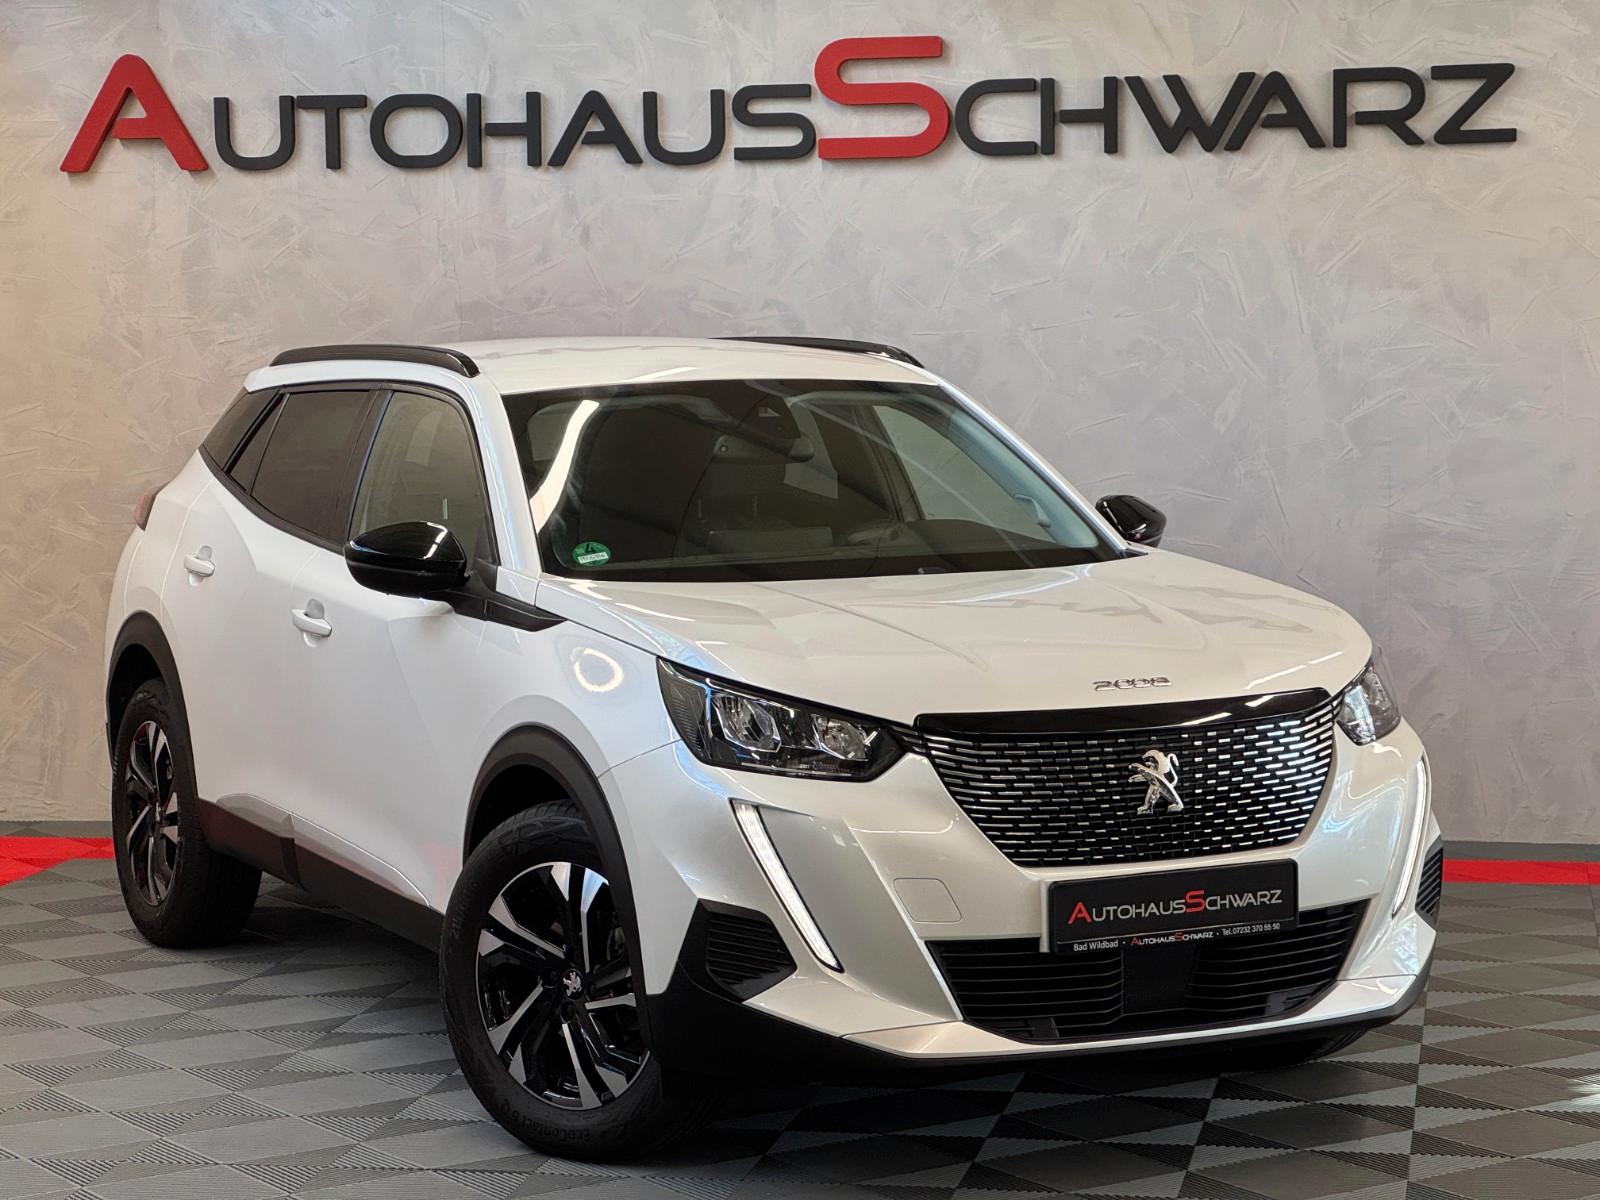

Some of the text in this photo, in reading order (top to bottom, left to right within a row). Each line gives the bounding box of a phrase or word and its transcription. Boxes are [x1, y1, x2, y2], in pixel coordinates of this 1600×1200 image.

[1093, 677, 1171, 691] 2008
[1073, 943, 1087, 951] Bad
[1089, 940, 1119, 950] Wildbad
[1251, 924, 1263, 933] 370
[1264, 923, 1272, 931] 55
[1272, 922, 1280, 930] 50
